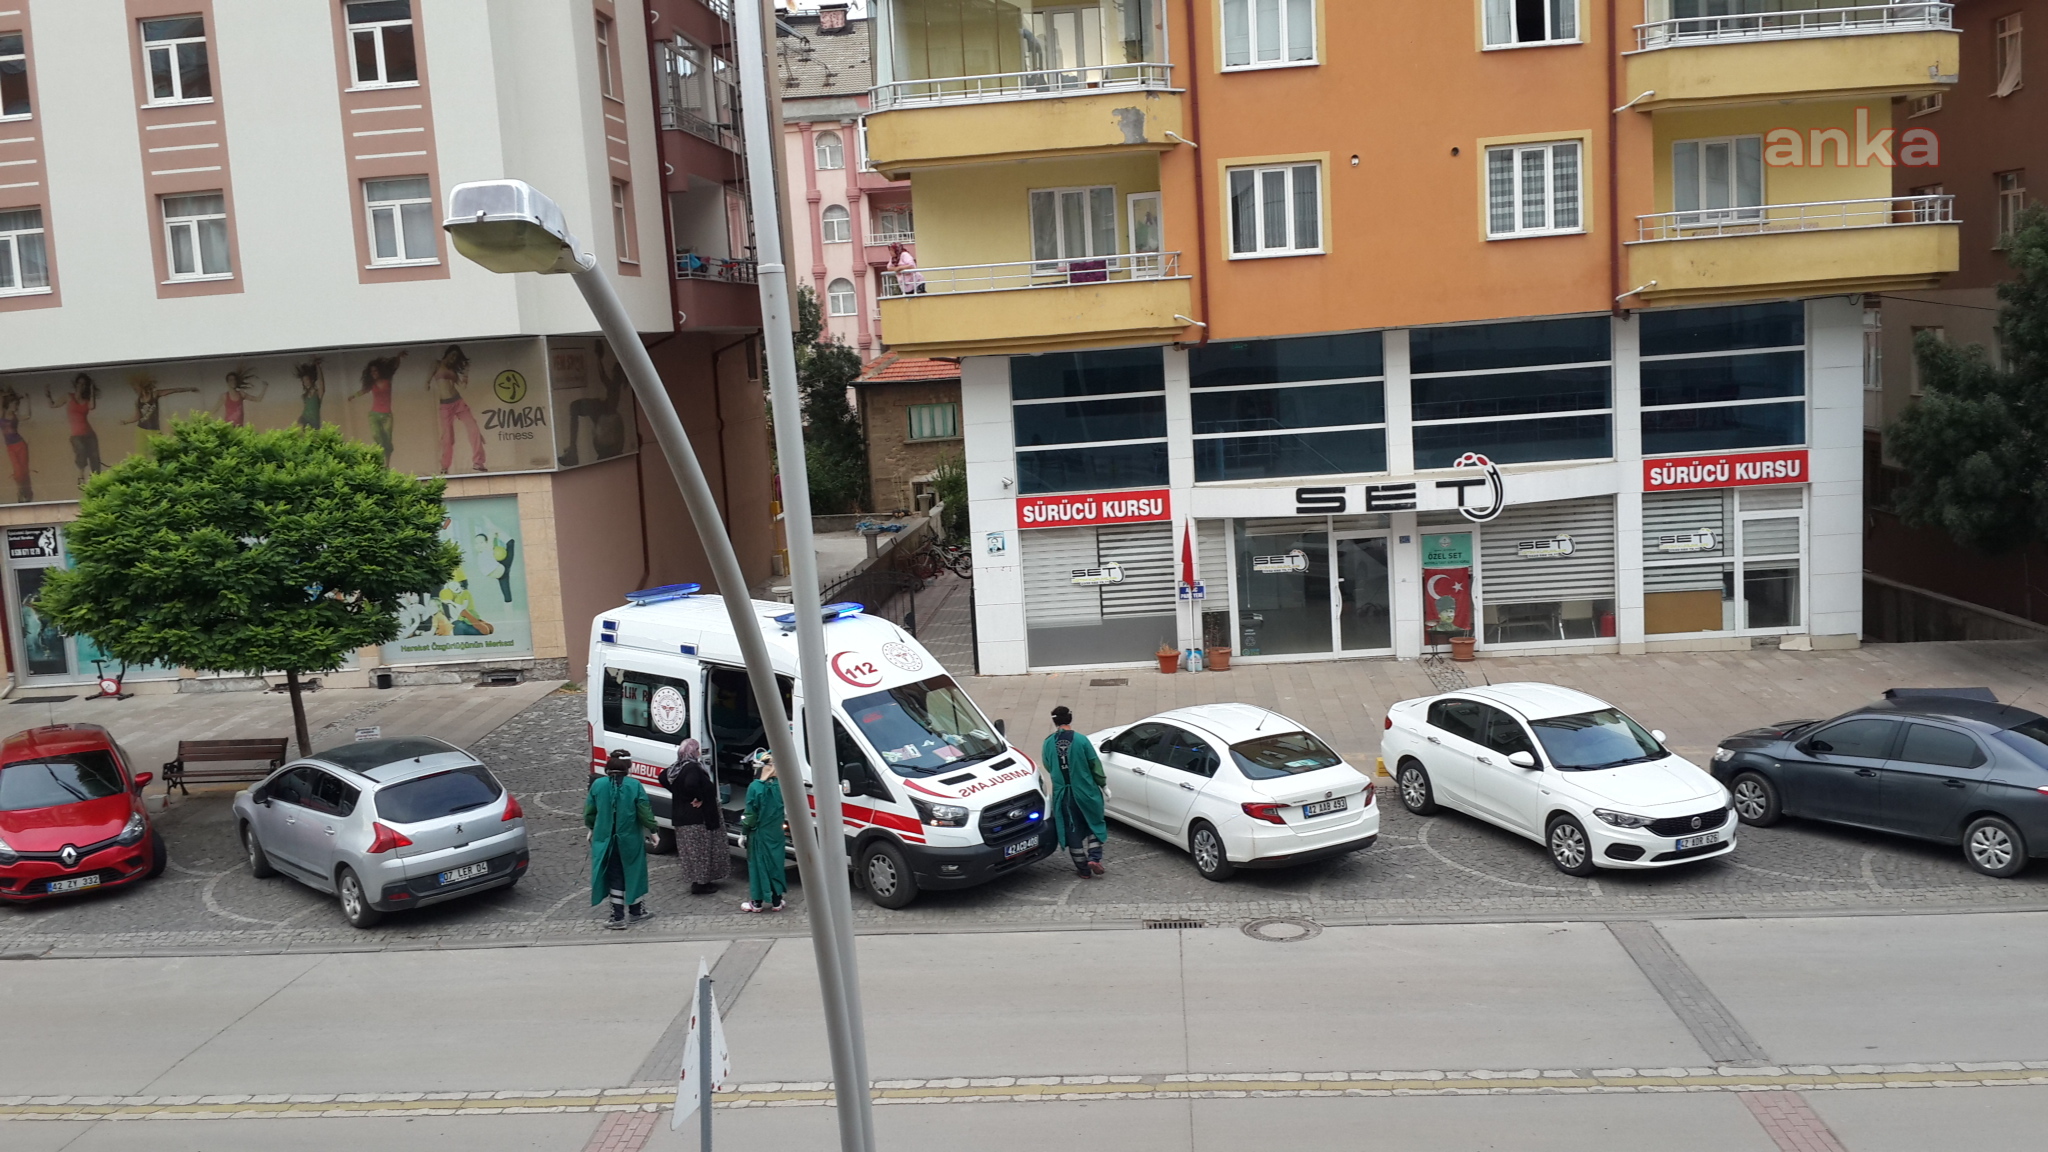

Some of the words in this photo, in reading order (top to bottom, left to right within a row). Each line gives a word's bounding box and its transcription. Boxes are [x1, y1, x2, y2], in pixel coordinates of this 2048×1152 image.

[481, 406, 547, 430] ZUMBA
[498, 431, 534, 441] fitness
[1650, 459, 1730, 485] SÜRÜCÜ
[1736, 459, 1800, 481] KURSU
[1296, 479, 1486, 514] SET
[1023, 498, 1097, 523] SÜRÜCÜ
[1102, 498, 1163, 518] KURSU
[1519, 539, 1566, 550] SET
[1660, 533, 1708, 544] SET
[1254, 554, 1300, 565] SET
[1428, 551, 1446, 560] ÖZEL
[1072, 567, 1116, 578] SET
[845, 661, 878, 679] 112
[628, 762, 665, 779] MBUL
[444, 870, 453, 880] 07
[458, 866, 473, 878] LER
[476, 862, 487, 873] 04
[67, 880, 77, 888] ZY
[82, 876, 98, 886] 332
